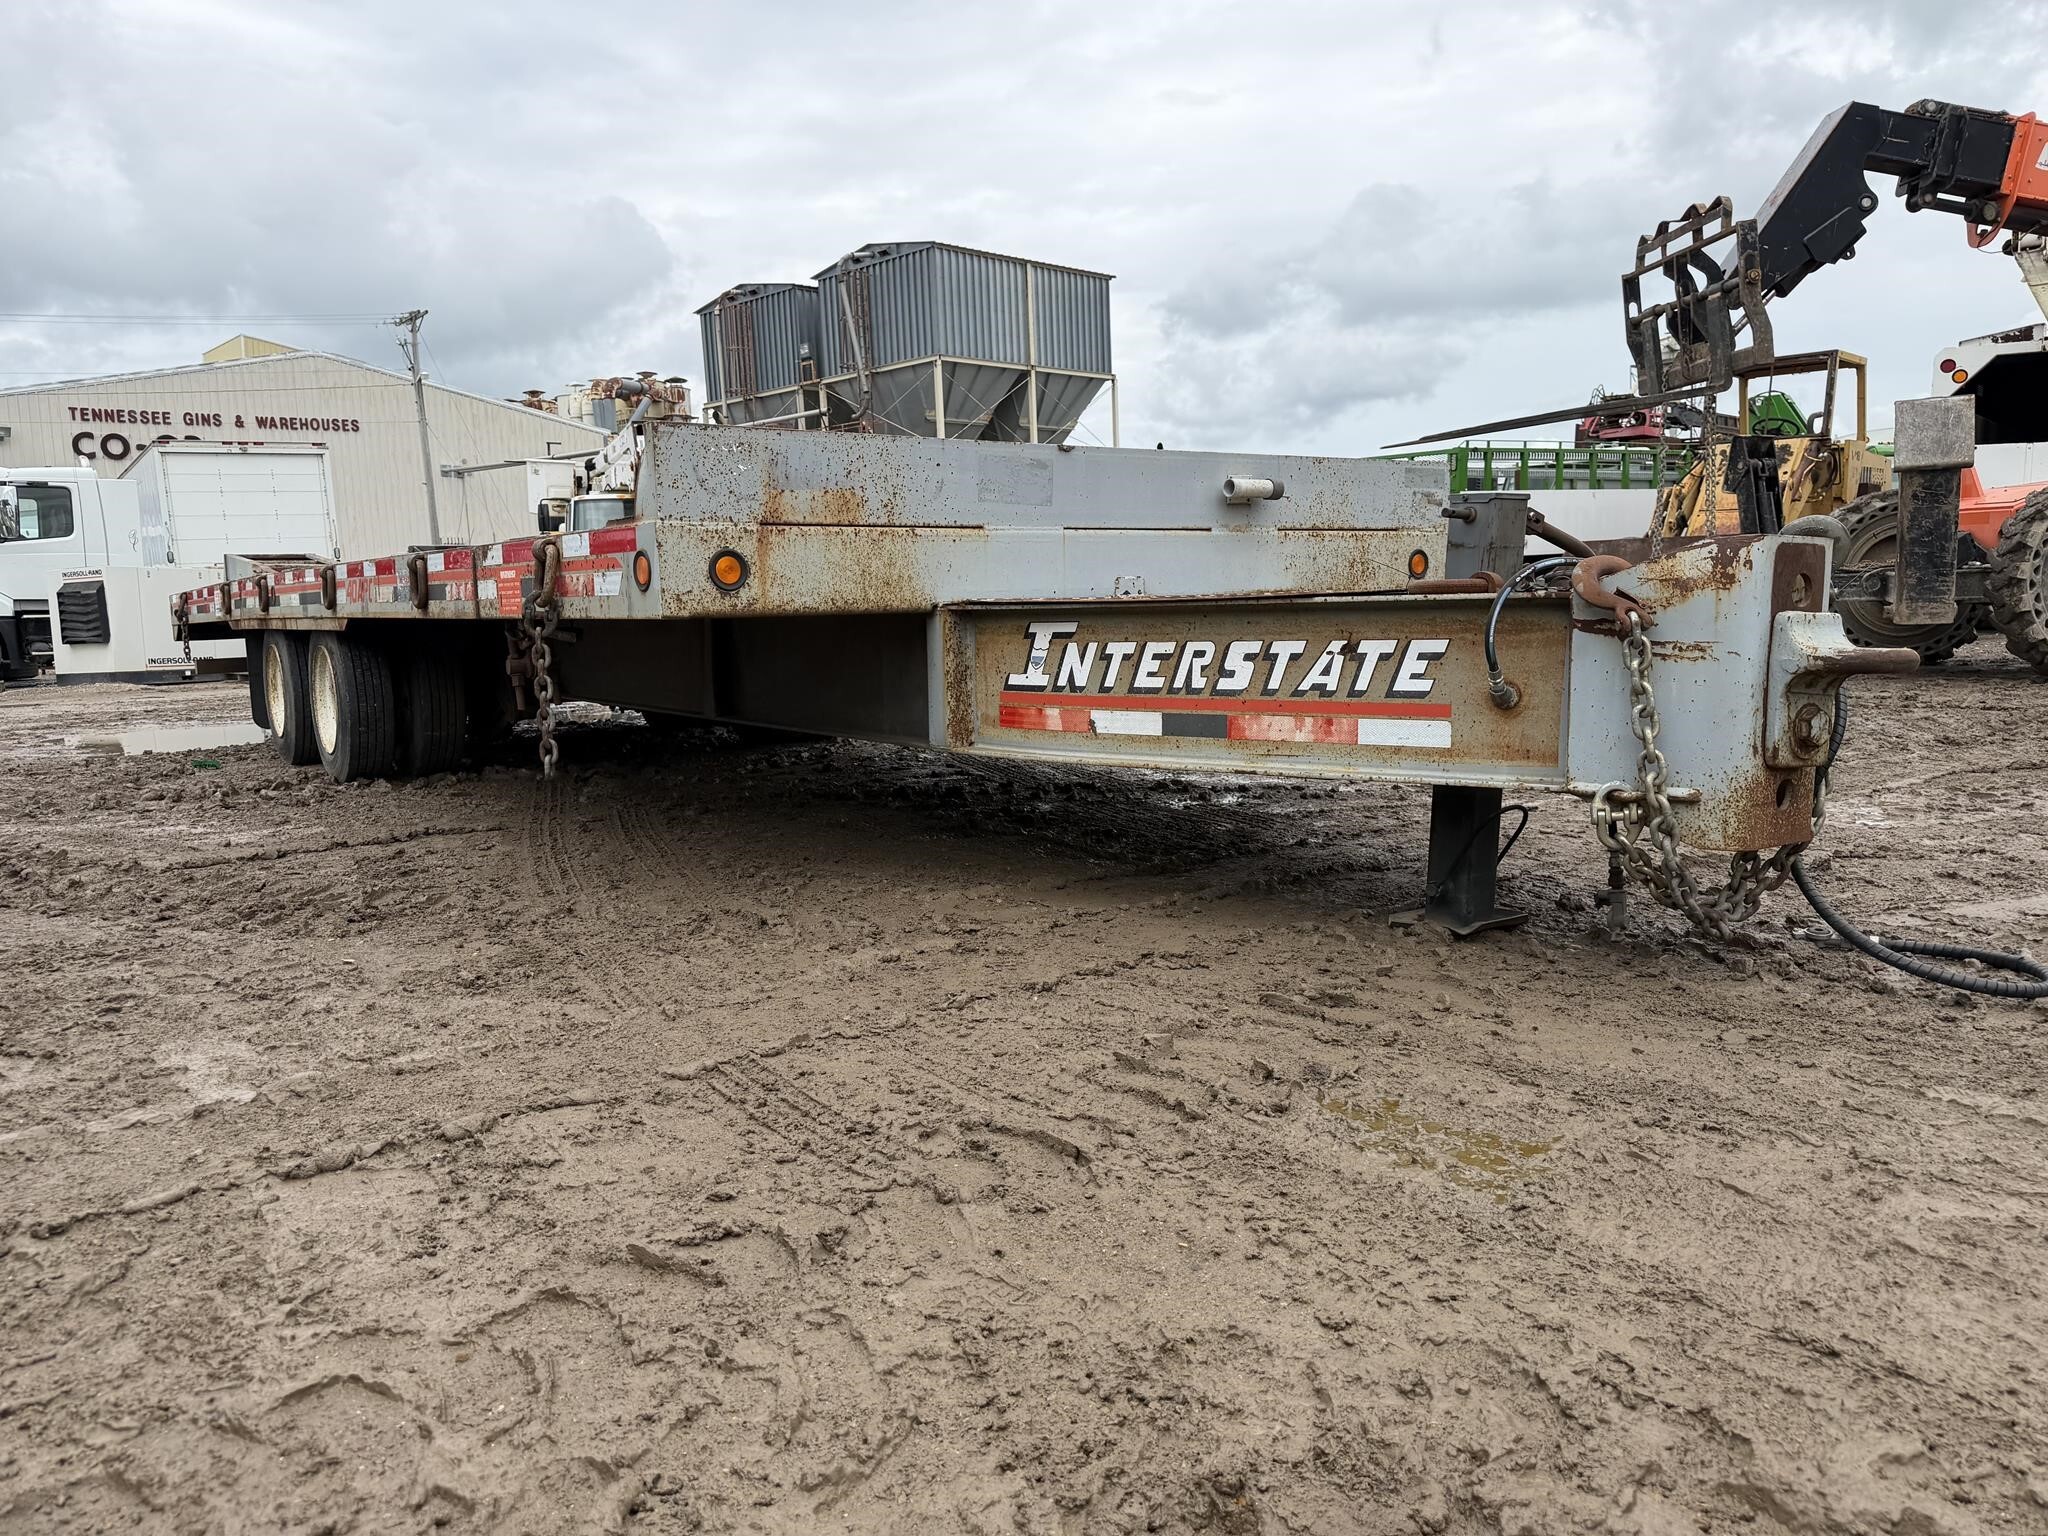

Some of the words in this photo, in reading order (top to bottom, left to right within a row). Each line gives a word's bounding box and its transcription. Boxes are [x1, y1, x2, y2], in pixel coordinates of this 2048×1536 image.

[68, 406, 172, 426] TENNESSEE
[183, 411, 223, 427] GINS
[234, 414, 245, 428] &
[255, 415, 361, 433] WAREHOUSES
[1004, 621, 1451, 698] INTERSTATE
